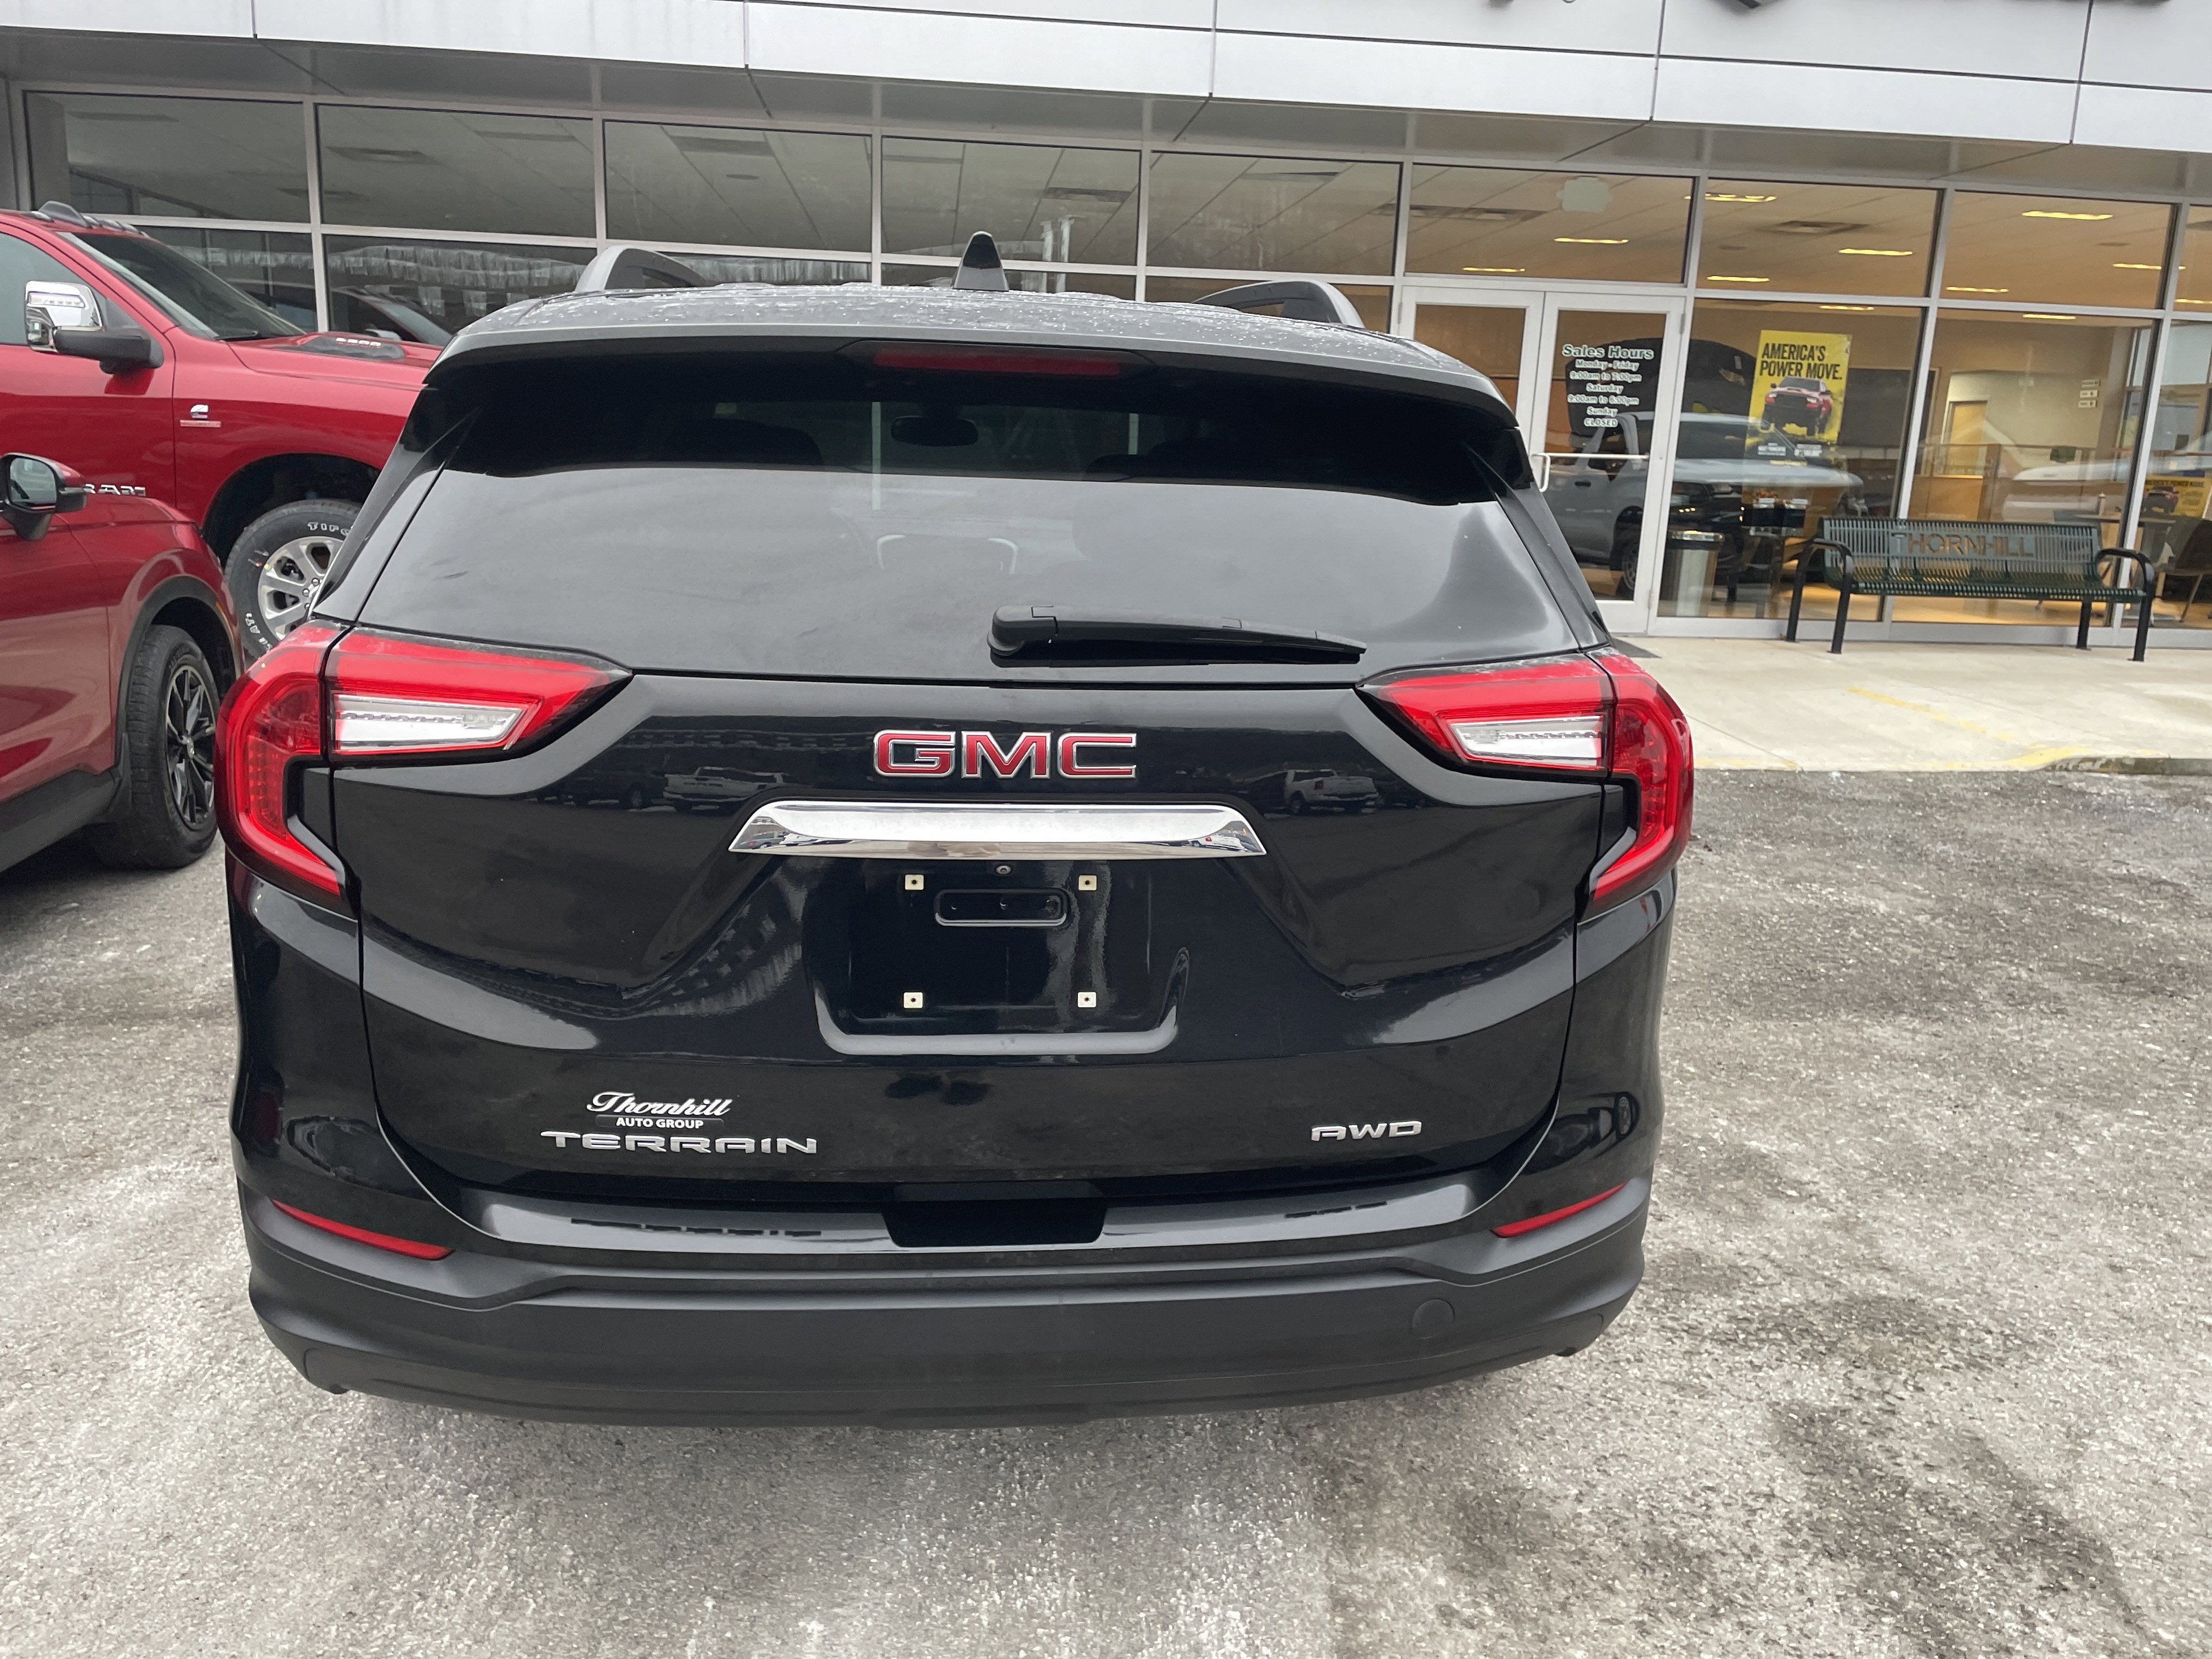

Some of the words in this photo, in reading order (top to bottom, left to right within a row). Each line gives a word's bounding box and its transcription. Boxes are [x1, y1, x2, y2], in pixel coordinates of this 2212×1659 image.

[1562, 343, 1605, 358] Sales
[1607, 345, 1654, 359] Hours
[1762, 342, 1826, 361] AMERICA'S
[1575, 359, 1608, 370] Monday
[1612, 360, 1639, 371] Friday
[1759, 360, 1803, 377] POWER
[1805, 363, 1842, 380] MOVE.
[1601, 371, 1611, 381] to
[1586, 382, 1624, 394] Saturday
[1598, 394, 1608, 404] to
[1587, 406, 1618, 417] Sunday
[1583, 417, 1618, 427] CLOSED
[1891, 532, 2034, 557] THORNHILL
[874, 730, 1137, 778] GMC
[586, 1091, 733, 1116] Thornhill
[616, 1117, 653, 1128] AUTO
[656, 1119, 704, 1129] GROUP
[1311, 1120, 1423, 1142] AWD
[540, 1131, 817, 1154] TERRAIN
